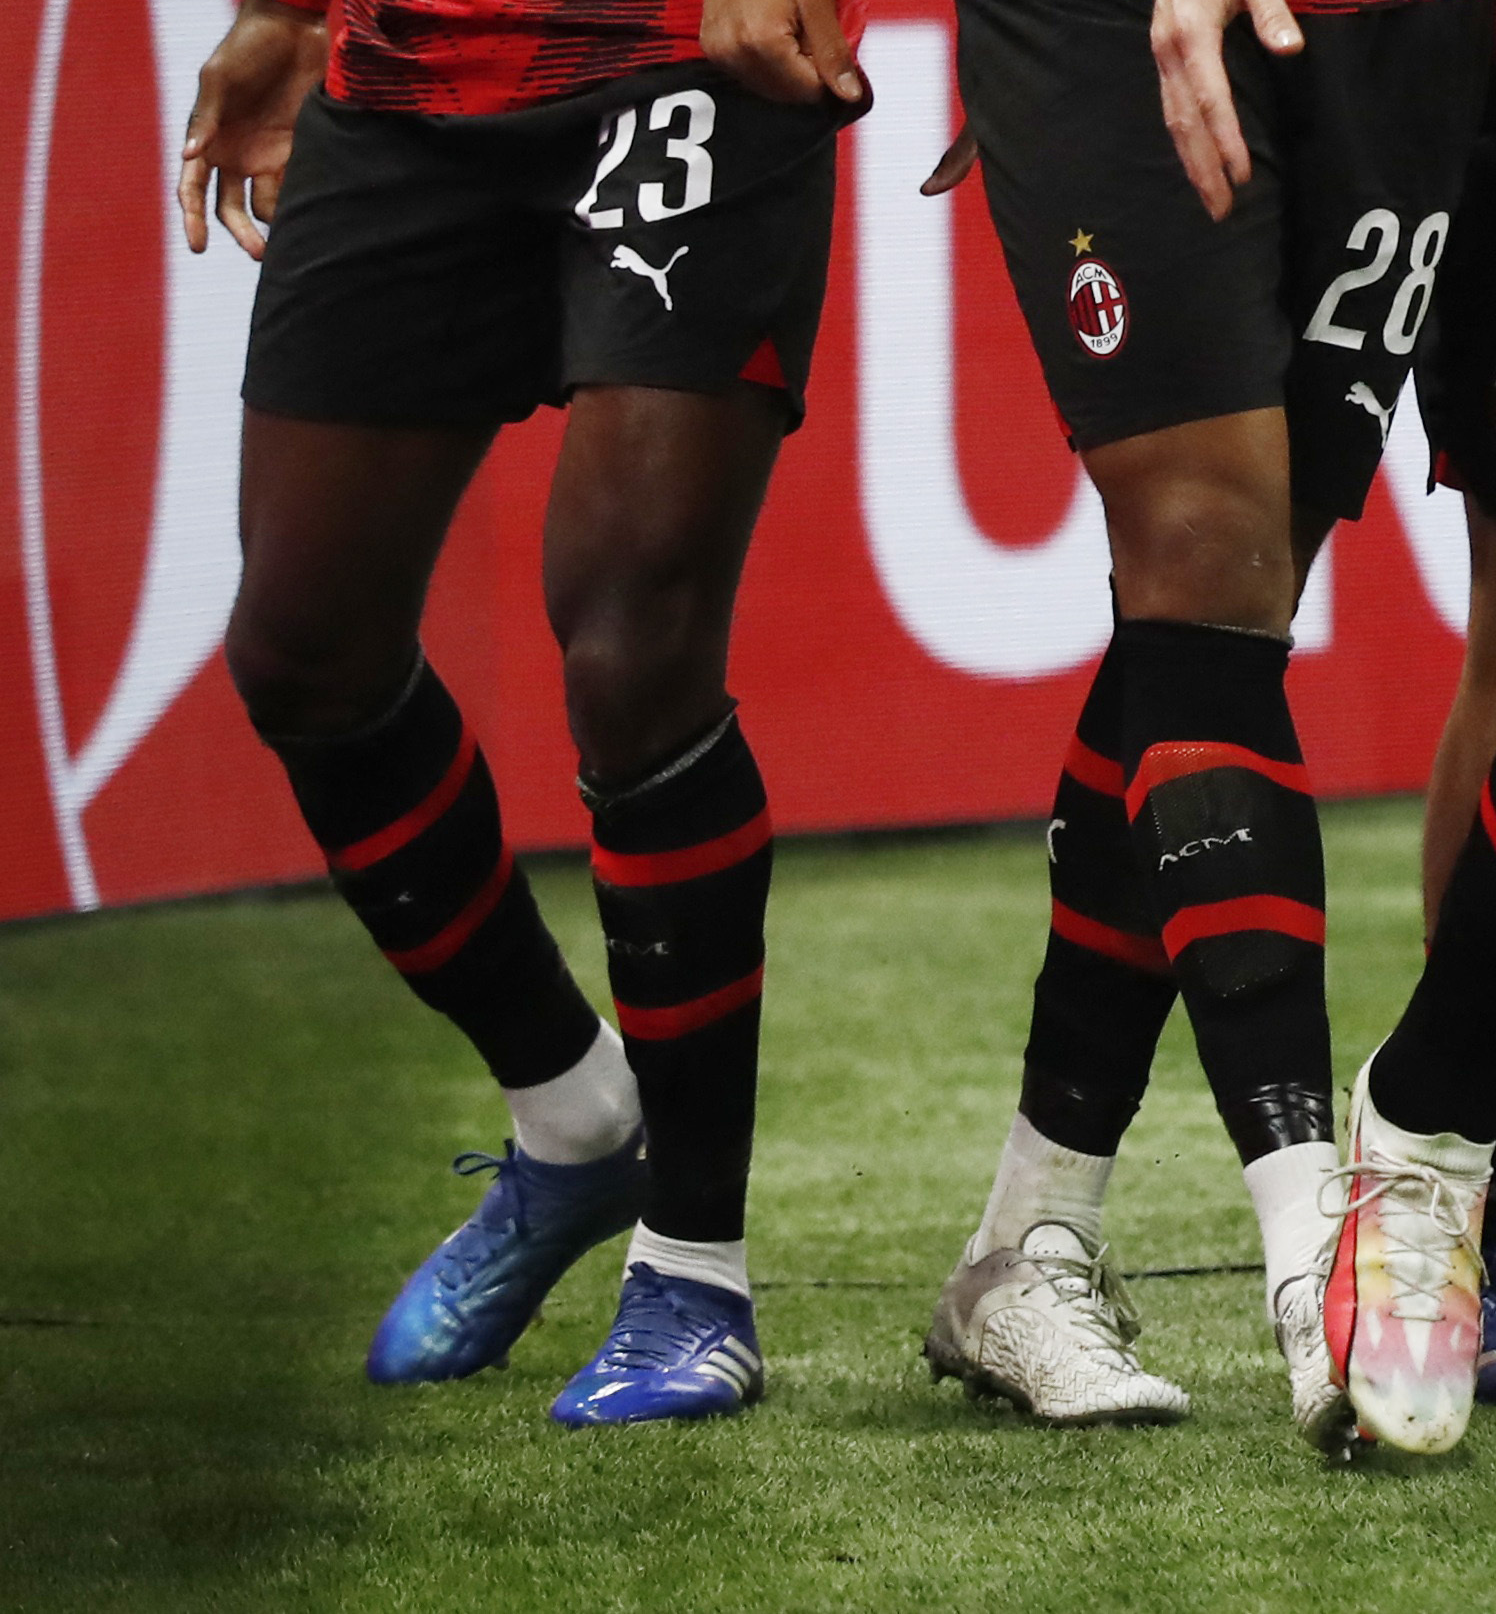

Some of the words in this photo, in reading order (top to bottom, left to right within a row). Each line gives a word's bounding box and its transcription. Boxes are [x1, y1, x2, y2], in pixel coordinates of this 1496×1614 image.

[575, 89, 716, 229] 23
[1075, 266, 1107, 288] ACM
[1302, 208, 1450, 355] 28
[1090, 332, 1118, 348] 1899
